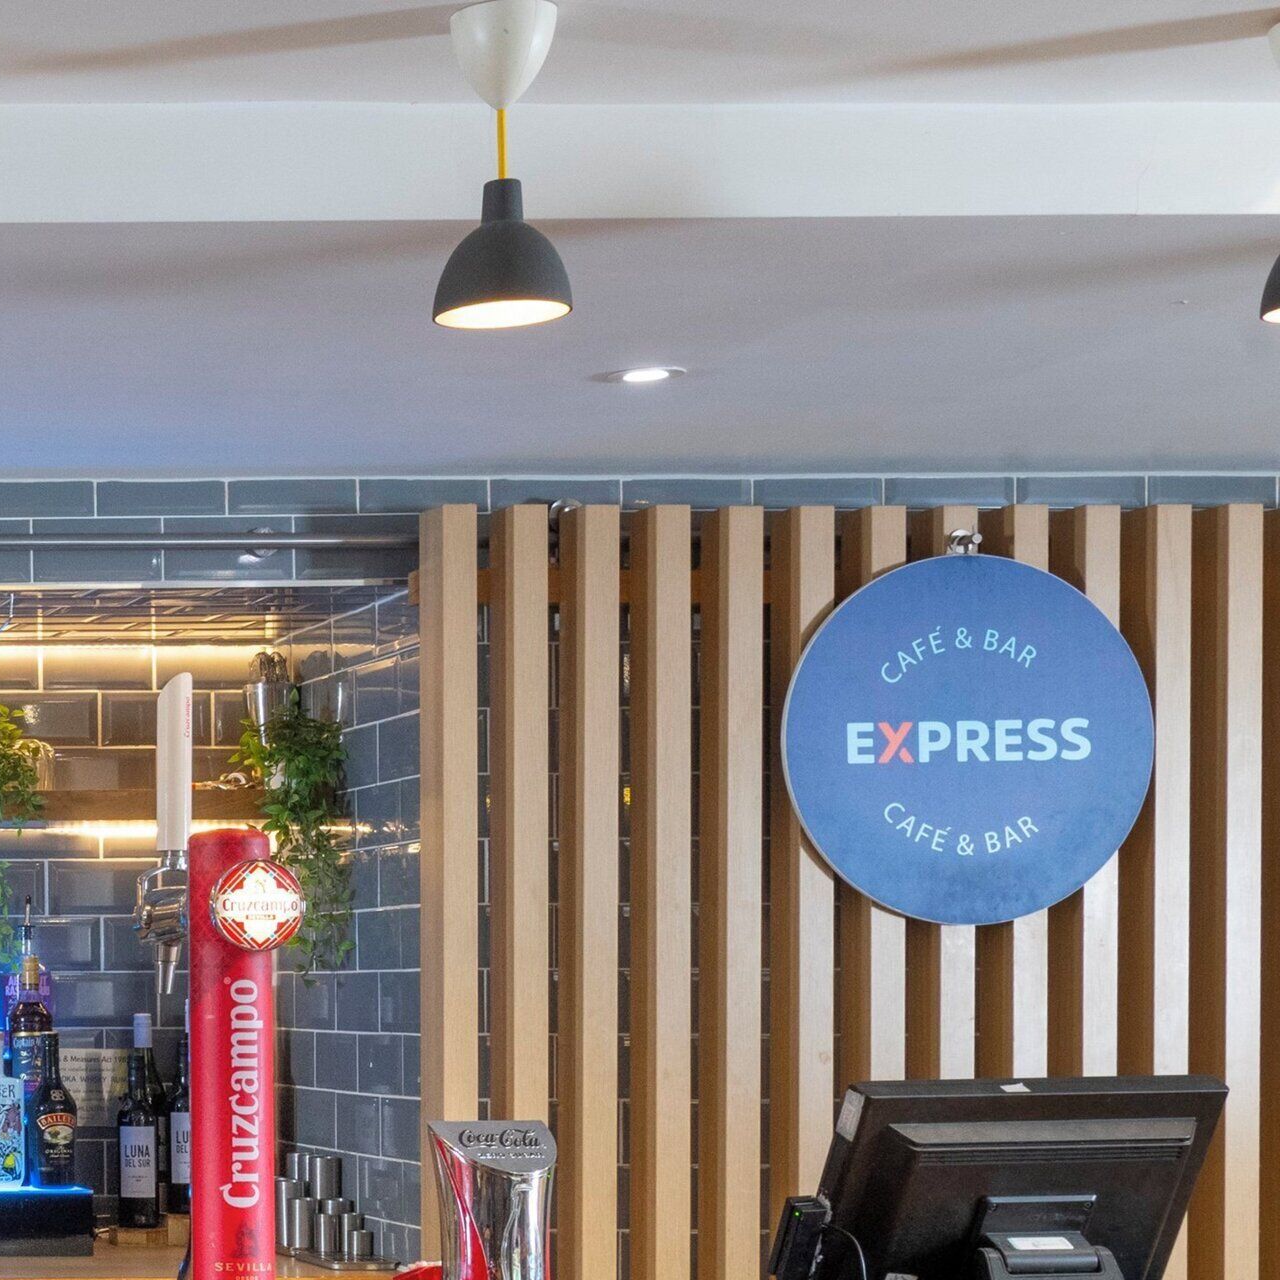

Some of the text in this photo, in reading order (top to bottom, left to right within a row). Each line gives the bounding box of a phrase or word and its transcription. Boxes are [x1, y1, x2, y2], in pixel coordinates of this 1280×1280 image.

[881, 626, 1037, 683] CAFÉ & BAR
[847, 718, 1091, 764] EXPRESS
[883, 803, 1039, 856] CAFÉ & BAR
[223, 899, 298, 913] Cruzcampo
[220, 979, 263, 1208] Cruzcampo
[459, 1129, 546, 1149] Coca-Cola
[124, 1145, 150, 1158] LUNA
[176, 1145, 188, 1154] DEL
[125, 1159, 151, 1168] DEL SUR
[214, 1262, 272, 1271] SEVILLA
